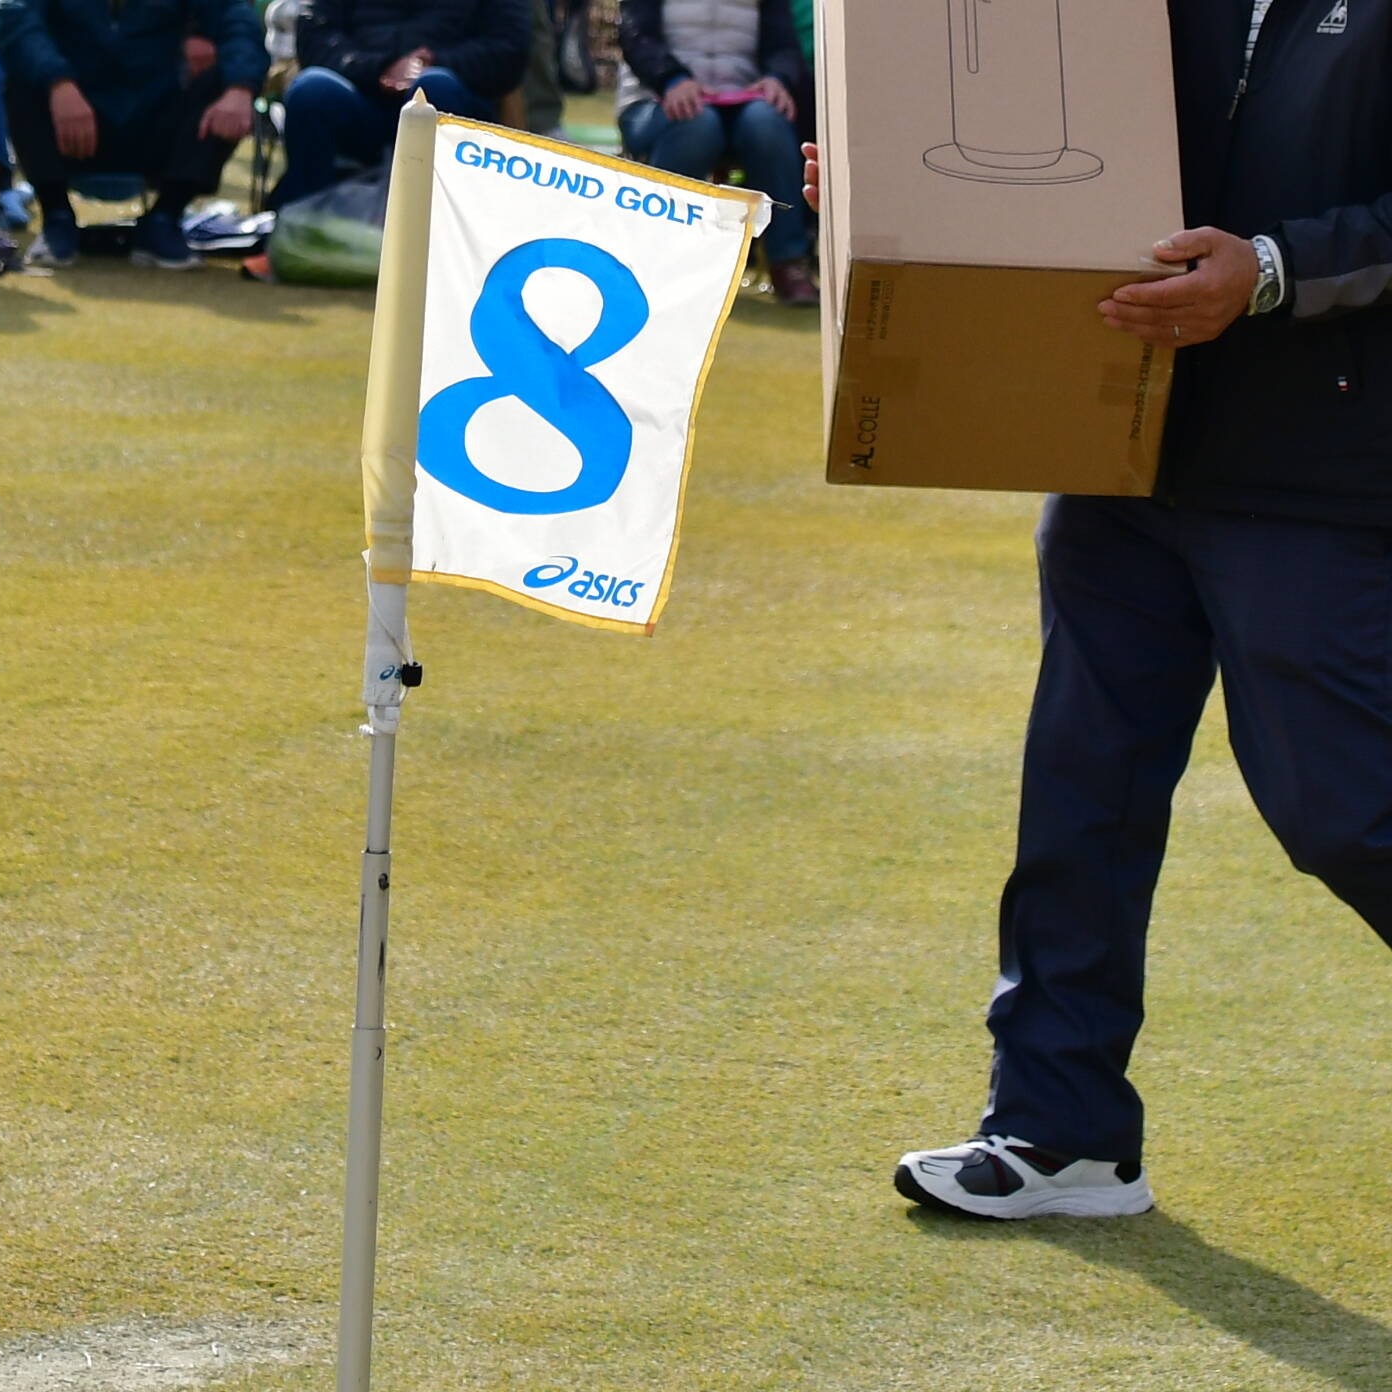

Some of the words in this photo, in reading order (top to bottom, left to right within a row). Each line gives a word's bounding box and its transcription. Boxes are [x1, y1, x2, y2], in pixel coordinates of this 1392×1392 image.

[455, 141, 604, 199] GROUND
[615, 186, 704, 226] GOLF
[417, 237, 650, 515] 8
